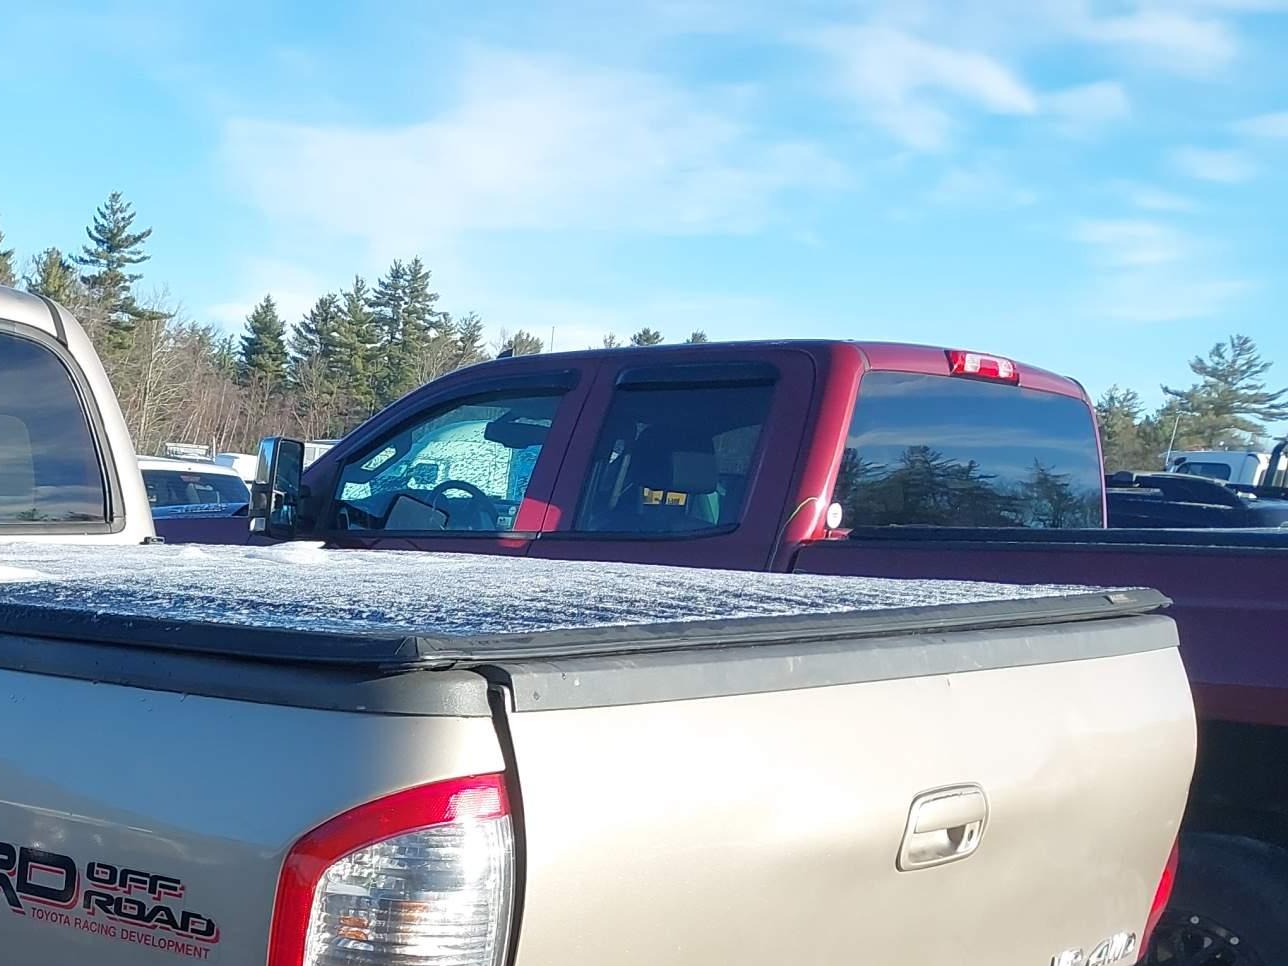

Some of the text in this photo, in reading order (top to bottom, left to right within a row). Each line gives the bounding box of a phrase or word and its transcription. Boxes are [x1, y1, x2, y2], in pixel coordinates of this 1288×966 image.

[86, 861, 185, 901] OFF
[31, 906, 211, 960] TOYOTA RACING DEVELOPMENT
[83, 889, 220, 944] ROAD
